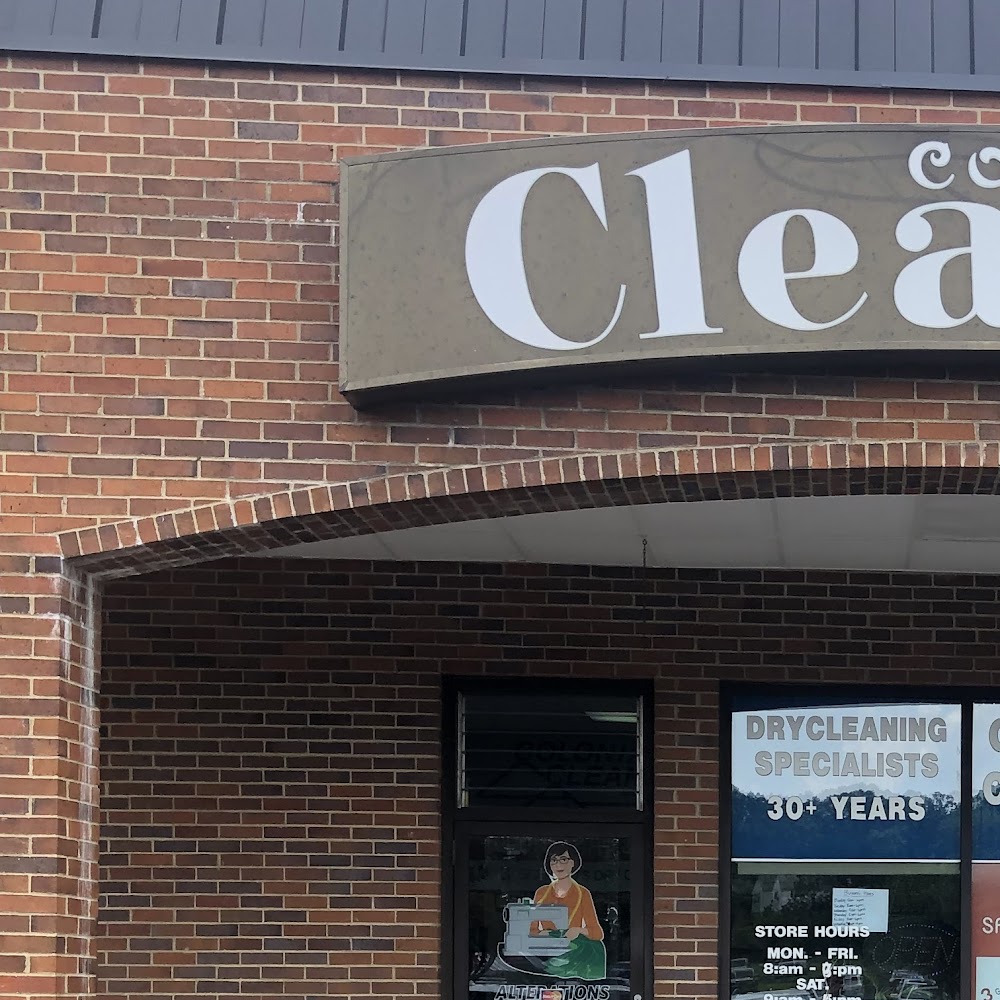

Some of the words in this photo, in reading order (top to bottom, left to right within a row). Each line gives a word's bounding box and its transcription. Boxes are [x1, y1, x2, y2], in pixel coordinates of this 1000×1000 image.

[746, 715, 947, 742] DRYCLEANING
[755, 751, 939, 778] SPECIALISTS
[767, 796, 817, 820] 30+
[830, 796, 926, 821] YEARS
[754, 925, 808, 938] STORE
[814, 925, 870, 938] HOURS
[767, 947, 808, 960] MON.
[827, 947, 858, 960] FRI.
[763, 963, 803, 975] 8:am
[796, 978, 829, 990] SAT.
[494, 984, 610, 1000] ALTERTIONS
